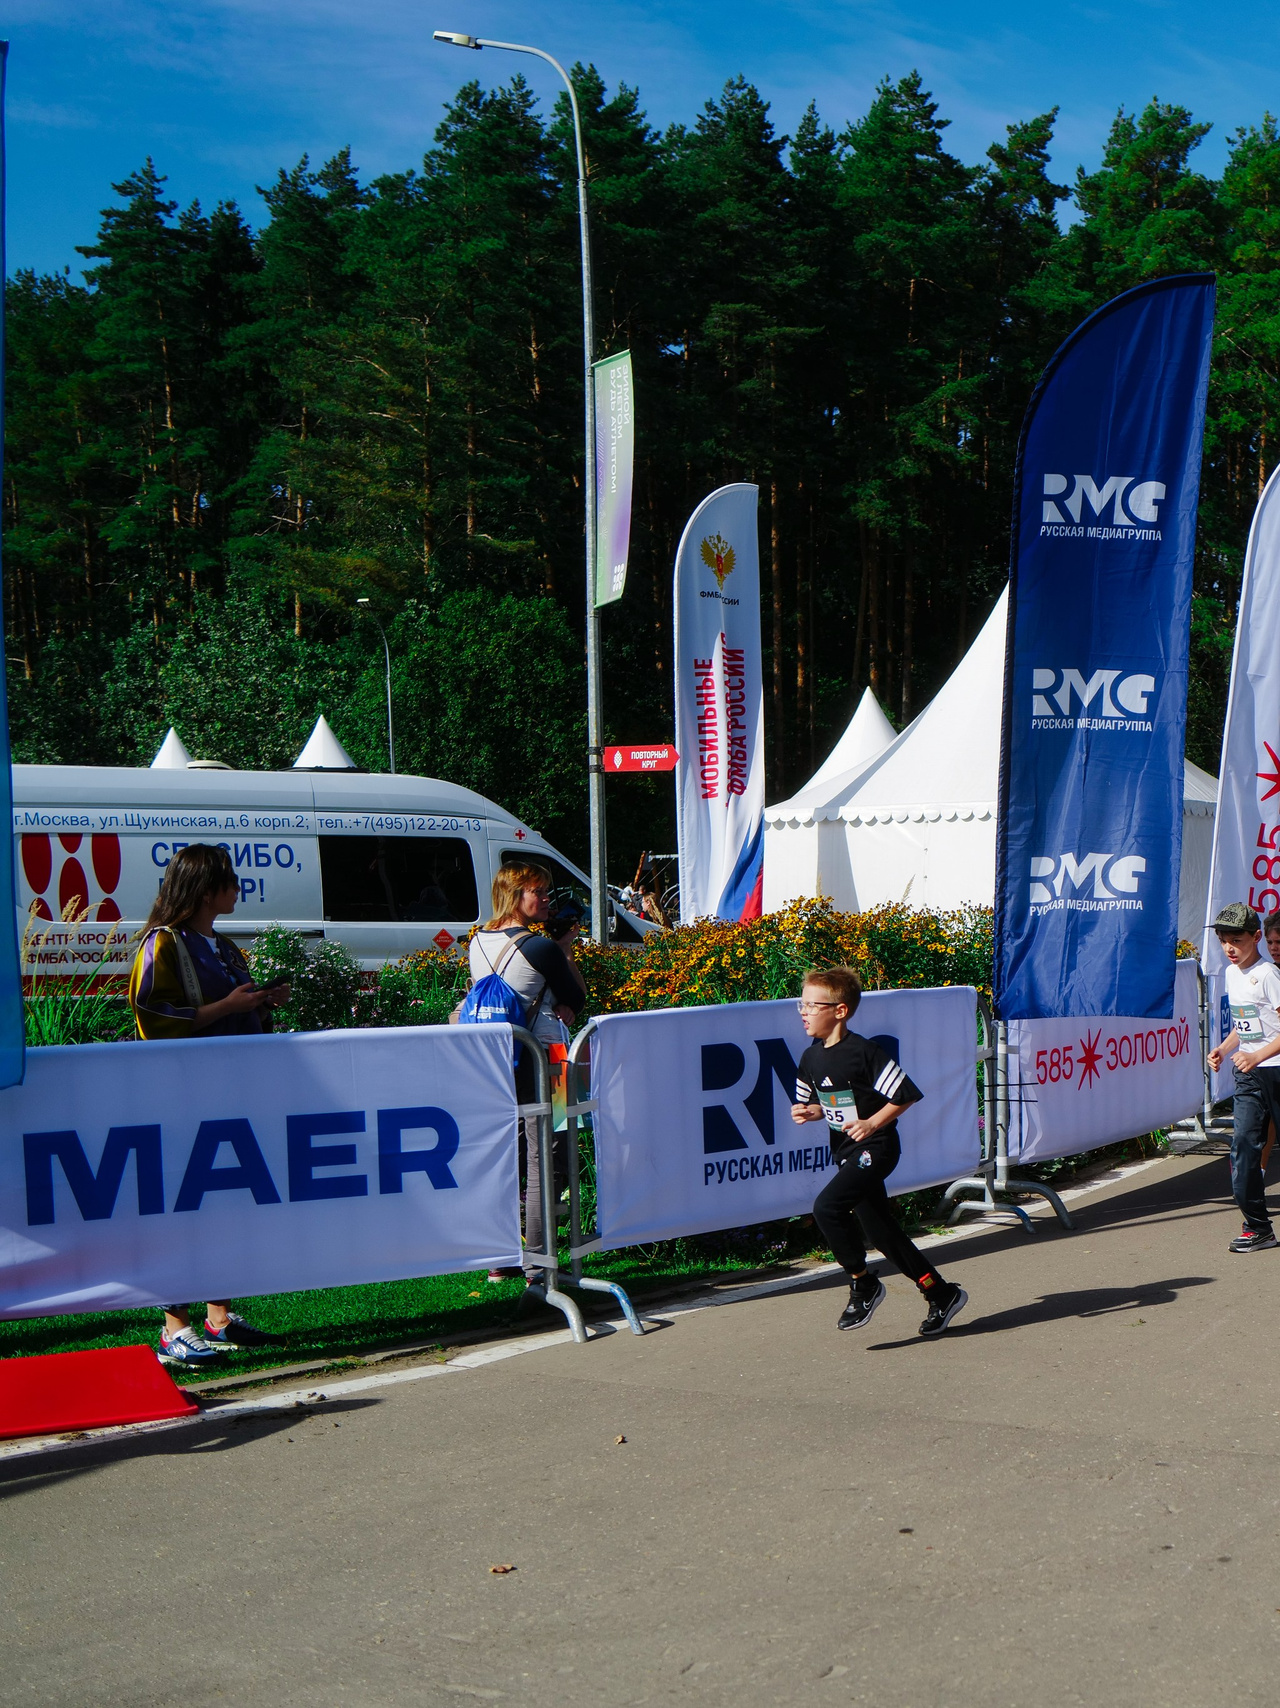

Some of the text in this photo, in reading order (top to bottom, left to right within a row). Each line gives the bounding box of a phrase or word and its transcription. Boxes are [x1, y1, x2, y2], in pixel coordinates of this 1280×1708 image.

[1042, 473, 1167, 526] RMG
[1039, 525, 1162, 541] РУССКАЯ МЕДИАГРУППА
[1032, 668, 1155, 718] RMG
[693, 658, 718, 800] МОБИЛЬНЫЕ
[1031, 717, 1153, 732] РУССКАЯ МЕДИАГРУППА
[630, 748, 669, 760] ПОВТОРНЫЙ
[641, 760, 658, 769] КРУГ
[151, 842, 302, 873] СИБО,
[1029, 851, 1146, 904] RMG
[1029, 898, 1143, 916] РУССКАЯ МЕДИАГРУППА
[78, 933, 127, 945] КРОВИ
[27, 951, 129, 964] ФМБА РОССИИ
[1035, 1016, 1190, 1085] 585 ЗОЛОТОЙ
[23, 1106, 460, 1226] MAER
[704, 1151, 784, 1186] РУССКАЯ
